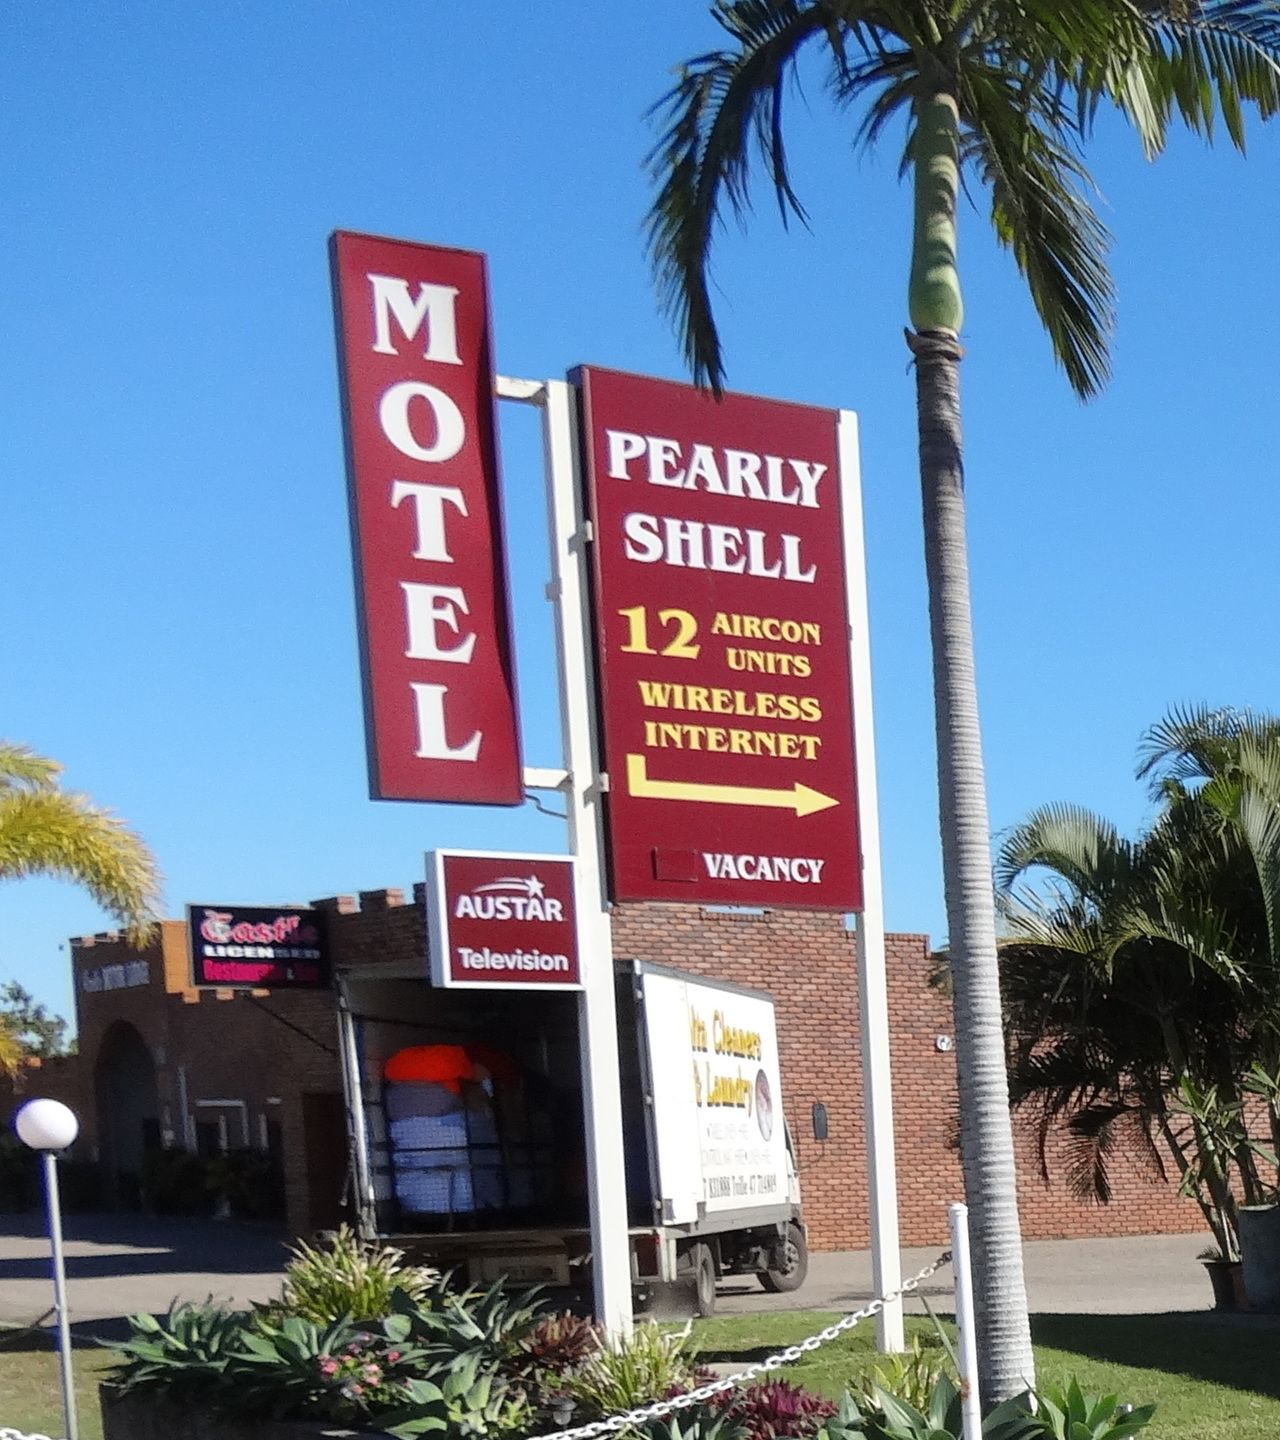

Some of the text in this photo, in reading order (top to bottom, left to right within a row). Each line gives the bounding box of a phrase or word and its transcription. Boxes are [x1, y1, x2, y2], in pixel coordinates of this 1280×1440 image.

[606, 429, 828, 509] PEARLY
[367, 273, 482, 762] MOTEL
[623, 512, 817, 583] SHELL
[618, 605, 822, 660] 12 AIRCON
[727, 648, 811, 677] UNITS
[638, 681, 823, 722] WIRELESS
[644, 721, 822, 761] INTERNET
[702, 853, 824, 884] VACANCY
[455, 895, 563, 922] AUSTAR
[457, 947, 569, 972] Television
[712, 1009, 762, 1062] Cleaners
[705, 1061, 753, 1118] Laundry
